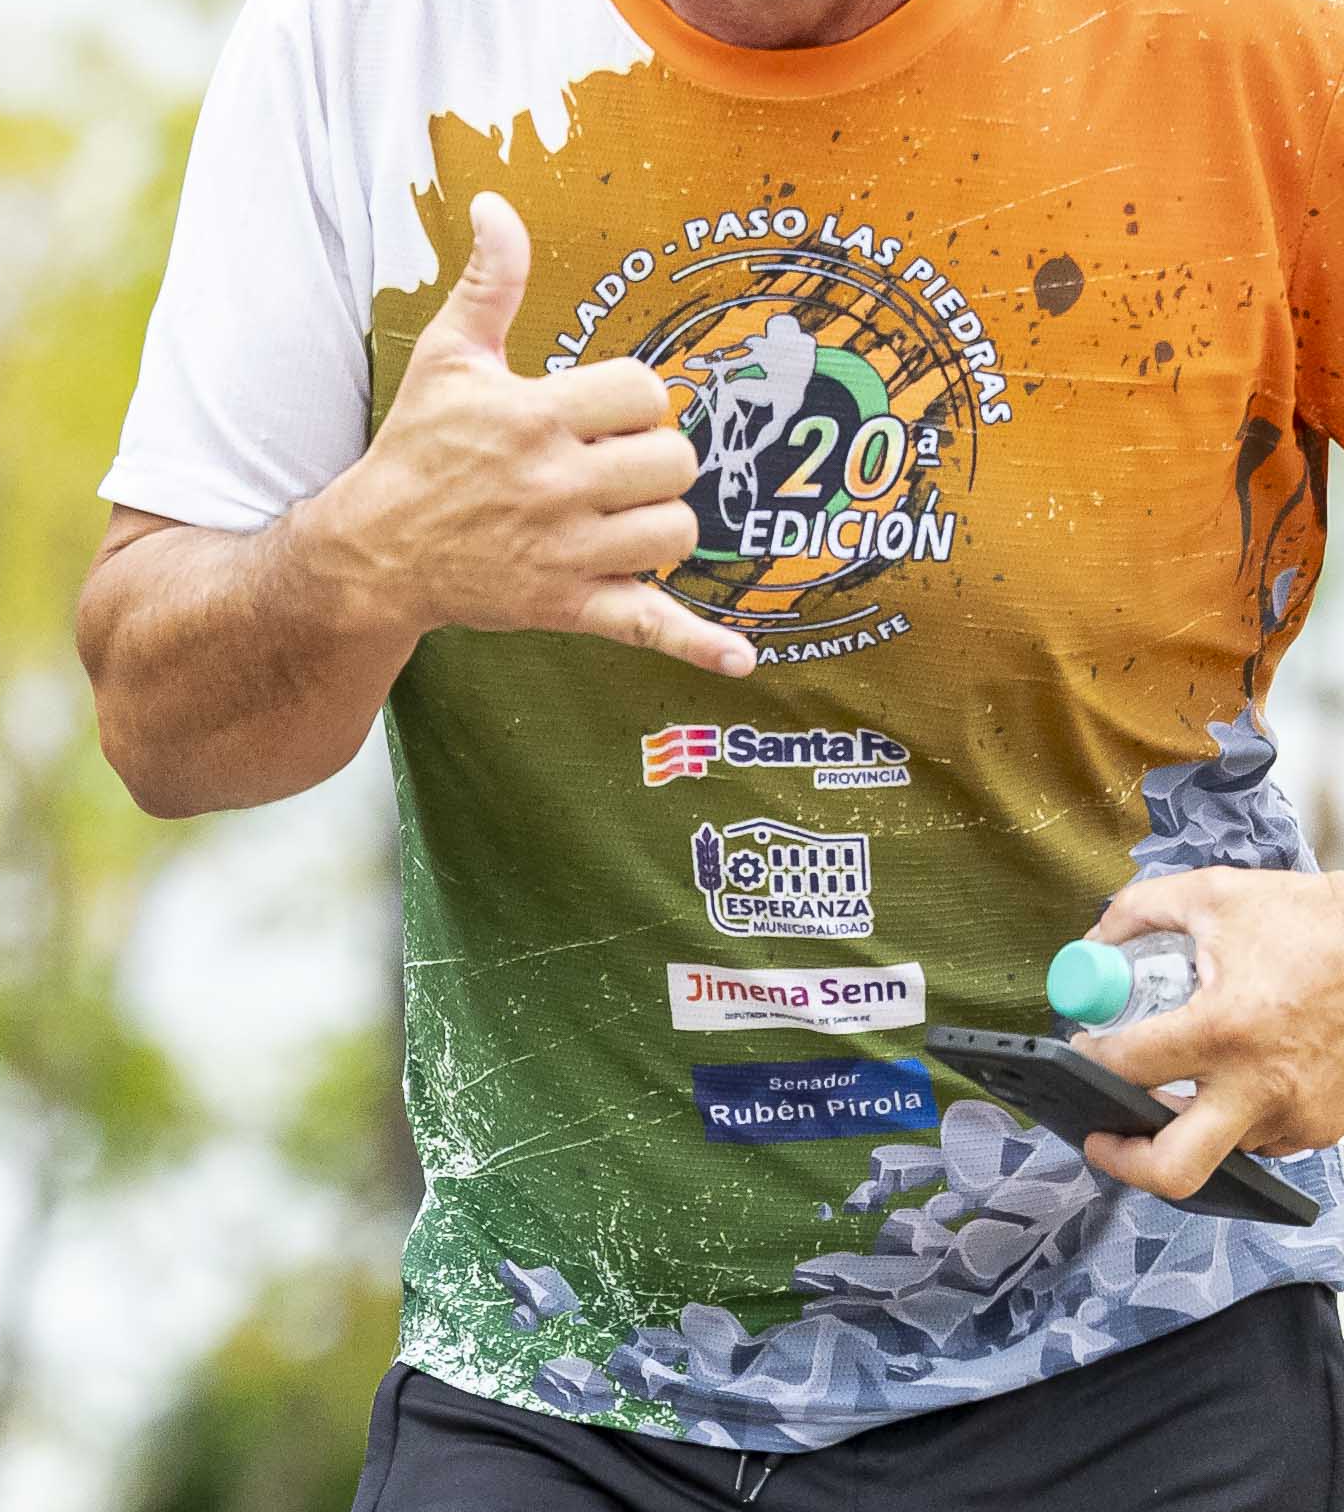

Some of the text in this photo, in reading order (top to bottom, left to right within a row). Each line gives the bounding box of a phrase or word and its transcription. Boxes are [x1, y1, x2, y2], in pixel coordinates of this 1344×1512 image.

[684, 207, 808, 252] PASO
[819, 215, 903, 267] LAS
[902, 257, 1012, 425] PIEDRAS
[739, 494, 956, 562] EDICIÓN
[876, 613, 912, 640] FE
[726, 728, 907, 763] Santa Fe
[817, 769, 908, 785] PROVINCIA
[726, 897, 870, 919] ESPERANZA
[752, 920, 870, 936] MUNICIPALIDAD
[687, 972, 907, 1007] Jimena Senn
[769, 1072, 862, 1091] Senador
[709, 1090, 923, 1127] Rubén Pirola
